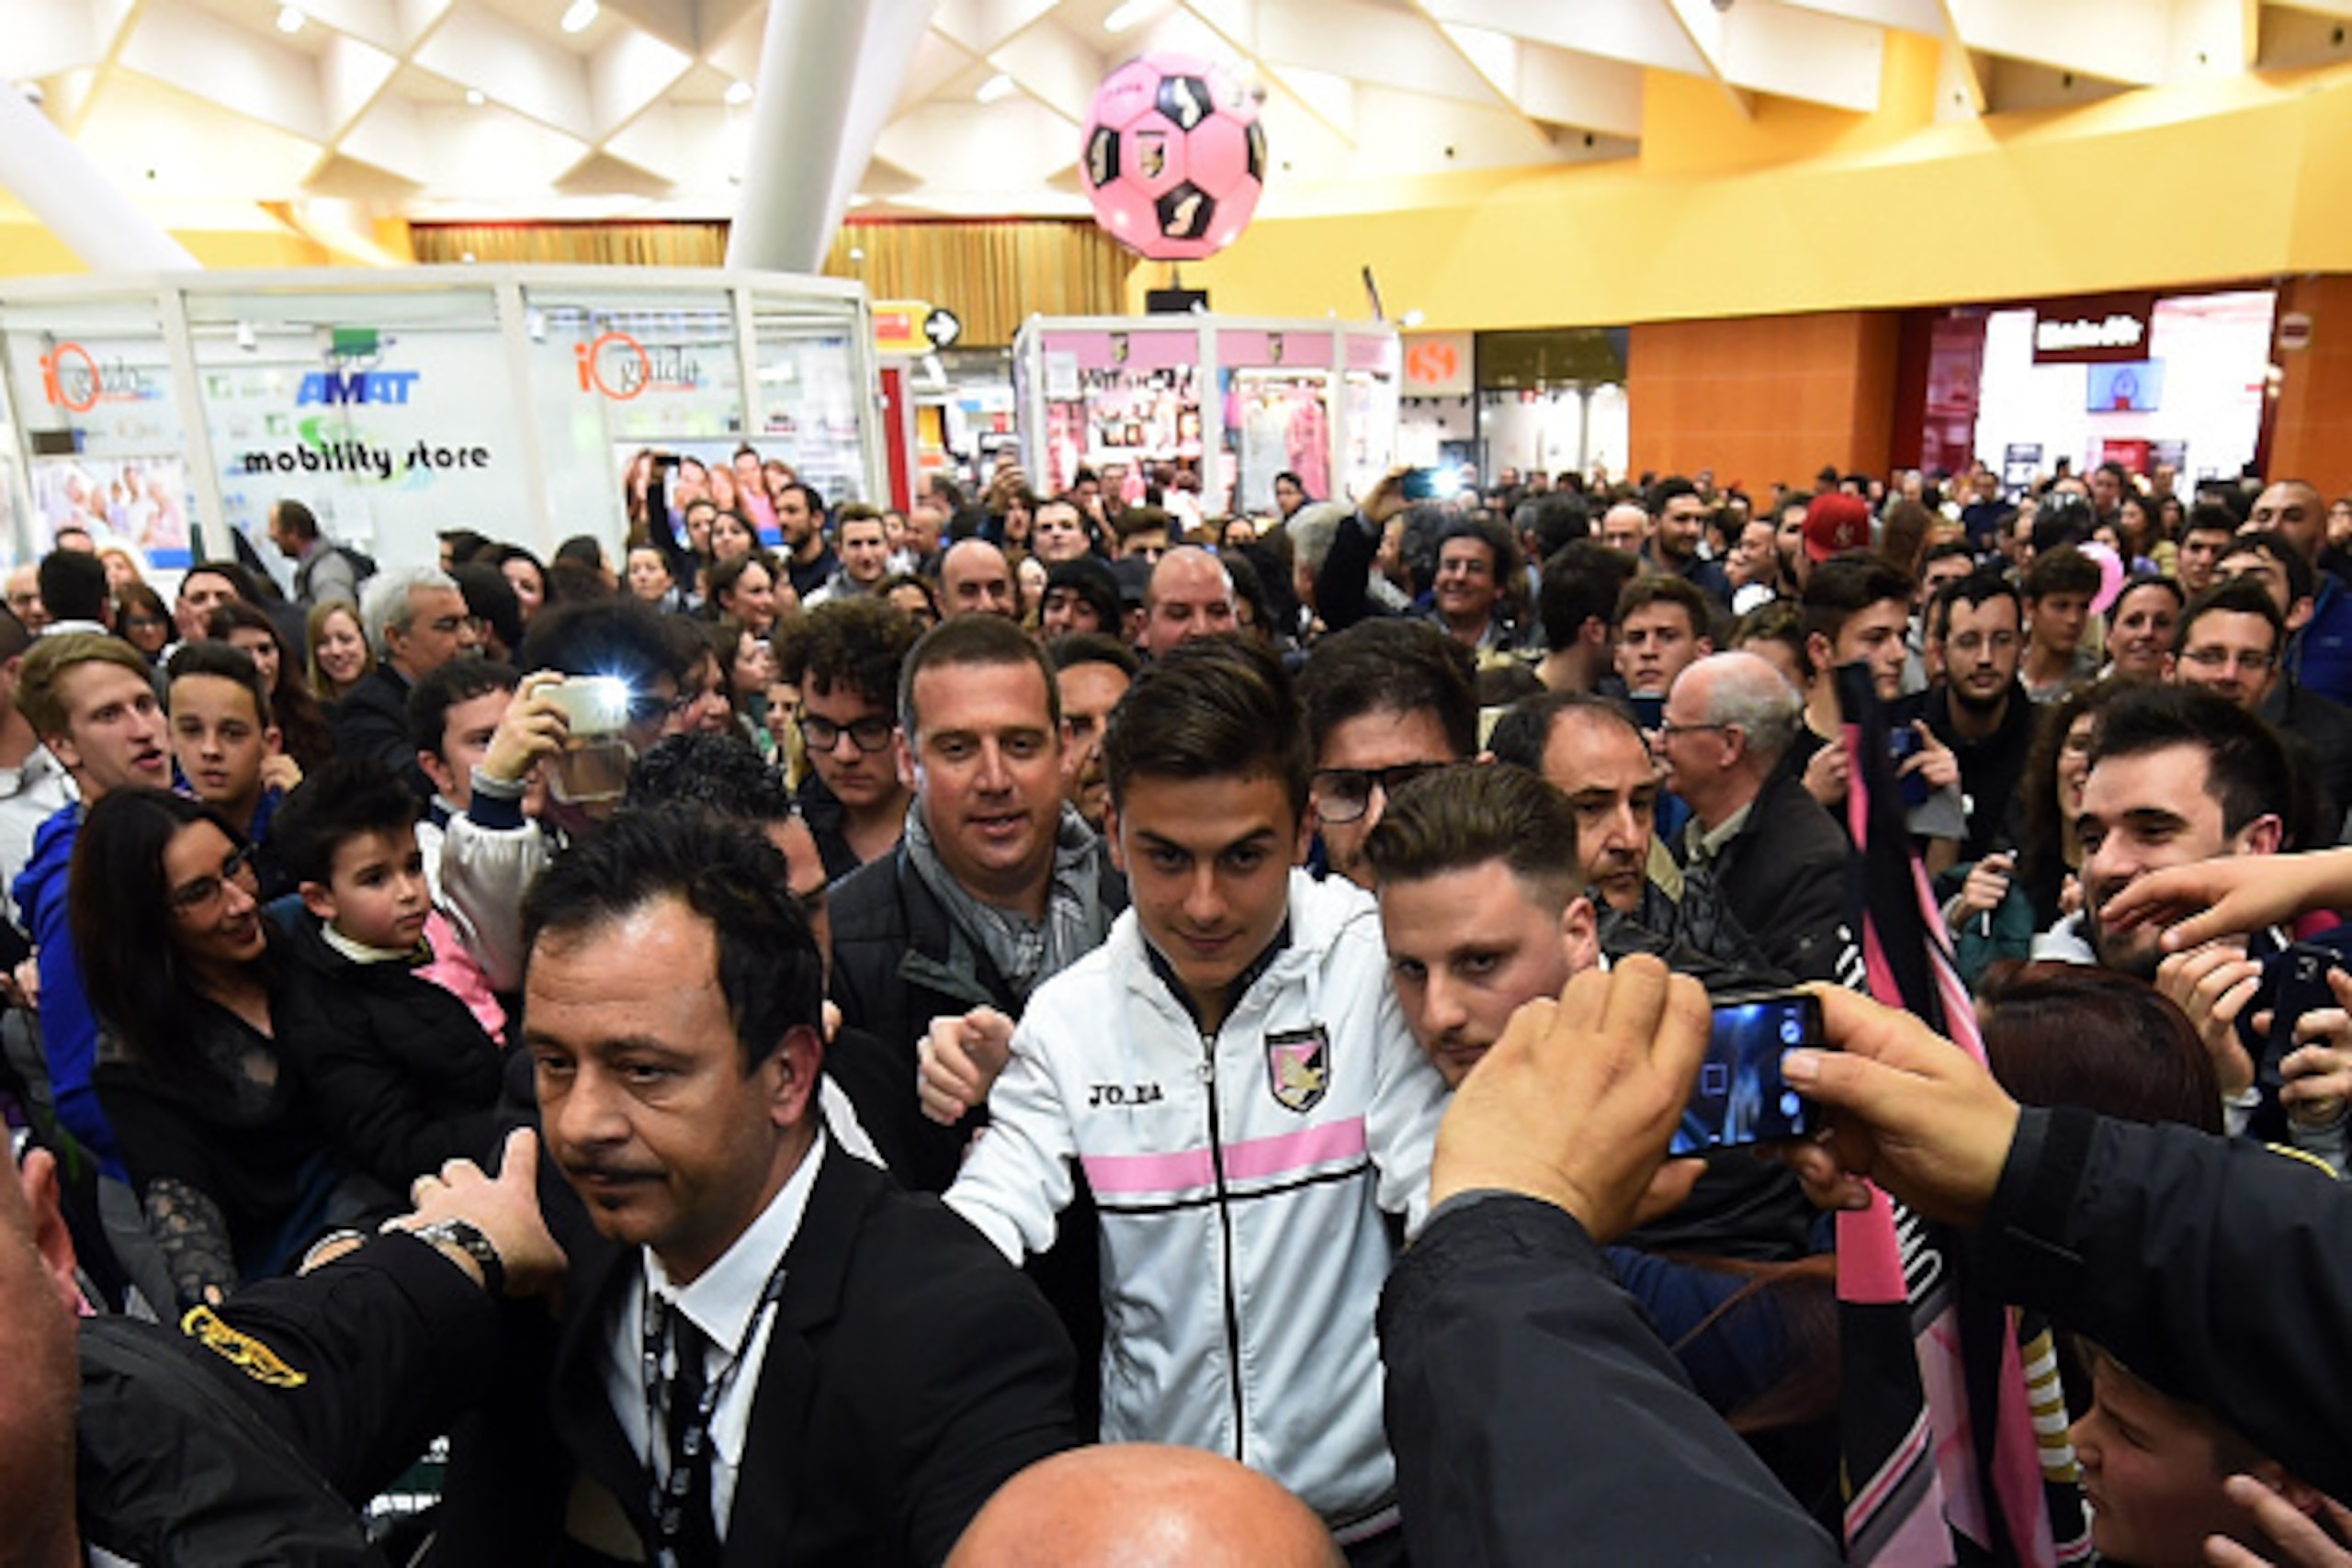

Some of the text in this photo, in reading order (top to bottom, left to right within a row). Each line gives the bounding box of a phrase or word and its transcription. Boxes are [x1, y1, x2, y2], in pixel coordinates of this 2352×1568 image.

[295, 369, 420, 406] AMAT
[243, 438, 491, 479] mobility store
